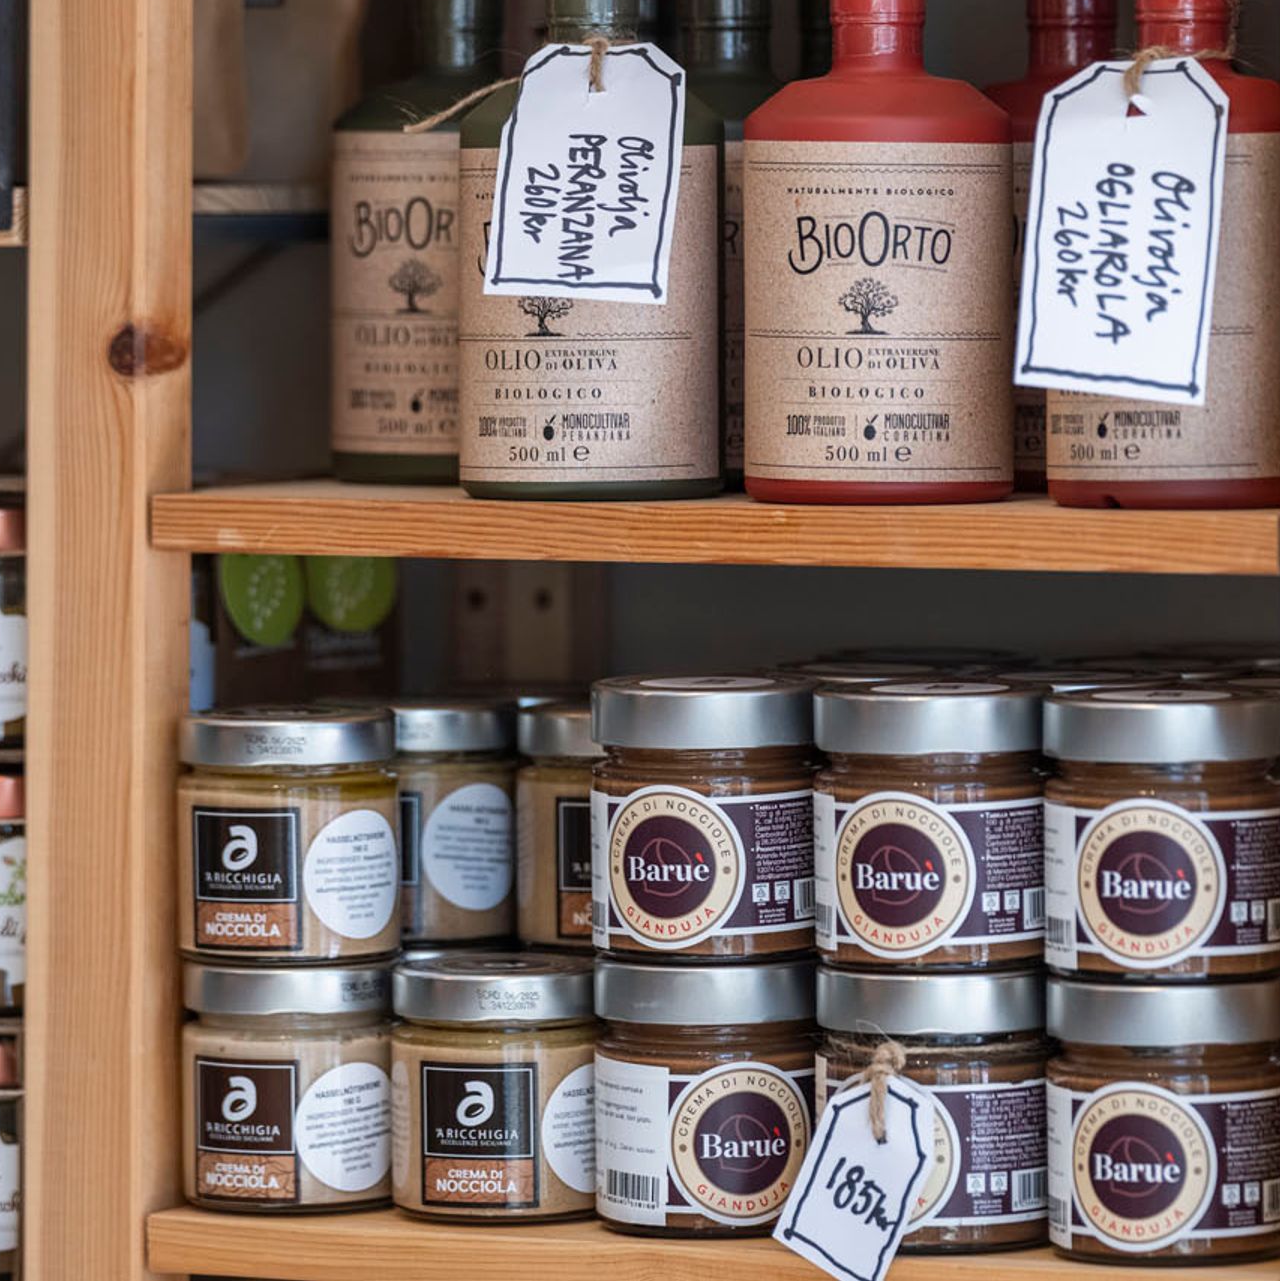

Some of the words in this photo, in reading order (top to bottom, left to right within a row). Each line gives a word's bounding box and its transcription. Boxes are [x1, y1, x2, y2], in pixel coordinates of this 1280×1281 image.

[787, 187, 879, 196] NATURALMENTE
[886, 188, 955, 196] BIOLOGICO
[556, 133, 607, 281] PERANZANA
[1089, 162, 1137, 346] OGLIAROLA
[485, 349, 540, 370] OLIO
[578, 349, 617, 357] VERGINE
[797, 346, 863, 369] OLIO
[545, 362, 558, 370] DI
[562, 358, 617, 370] OLIVA
[868, 361, 881, 369] DI
[886, 357, 940, 370] OLIVA
[495, 388, 601, 399] BIOLOGICO
[808, 386, 925, 399] BIOLOGICO
[562, 413, 630, 430] MONOCULTIVAR
[786, 415, 811, 436] 100%
[884, 413, 950, 430] MONOCULTIVAR
[1113, 411, 1182, 426] MONOCULTIVAR
[562, 431, 630, 441] PERANZANA
[883, 430, 950, 442] CORATINA
[509, 446, 539, 461] 500
[546, 447, 566, 461] ml
[825, 445, 859, 461] 500
[867, 446, 887, 462] ml
[1069, 444, 1097, 462] 500
[1100, 443, 1118, 461] ml
[665, 798, 733, 860] NOCCIOLE
[895, 806, 963, 869] NOCCIOLE
[1147, 814, 1213, 877] NOCCIOLE
[205, 922, 281, 937] NOCCIOLA
[624, 905, 717, 936] GIANDUJA
[853, 913, 945, 946] GIANDUJA
[1096, 923, 1194, 953] GIANDUJA
[747, 1075, 803, 1136] NOCCIOLE
[1136, 1097, 1202, 1159] NOCCIOLE
[206, 1171, 280, 1189] NOCCIOLA
[448, 1169, 487, 1178] CREMA
[490, 1170, 503, 1179] DI
[436, 1179, 517, 1193] NOCCIOLA
[696, 1179, 791, 1213] GIANDUJA
[1091, 1204, 1184, 1236] GIANDUJA
